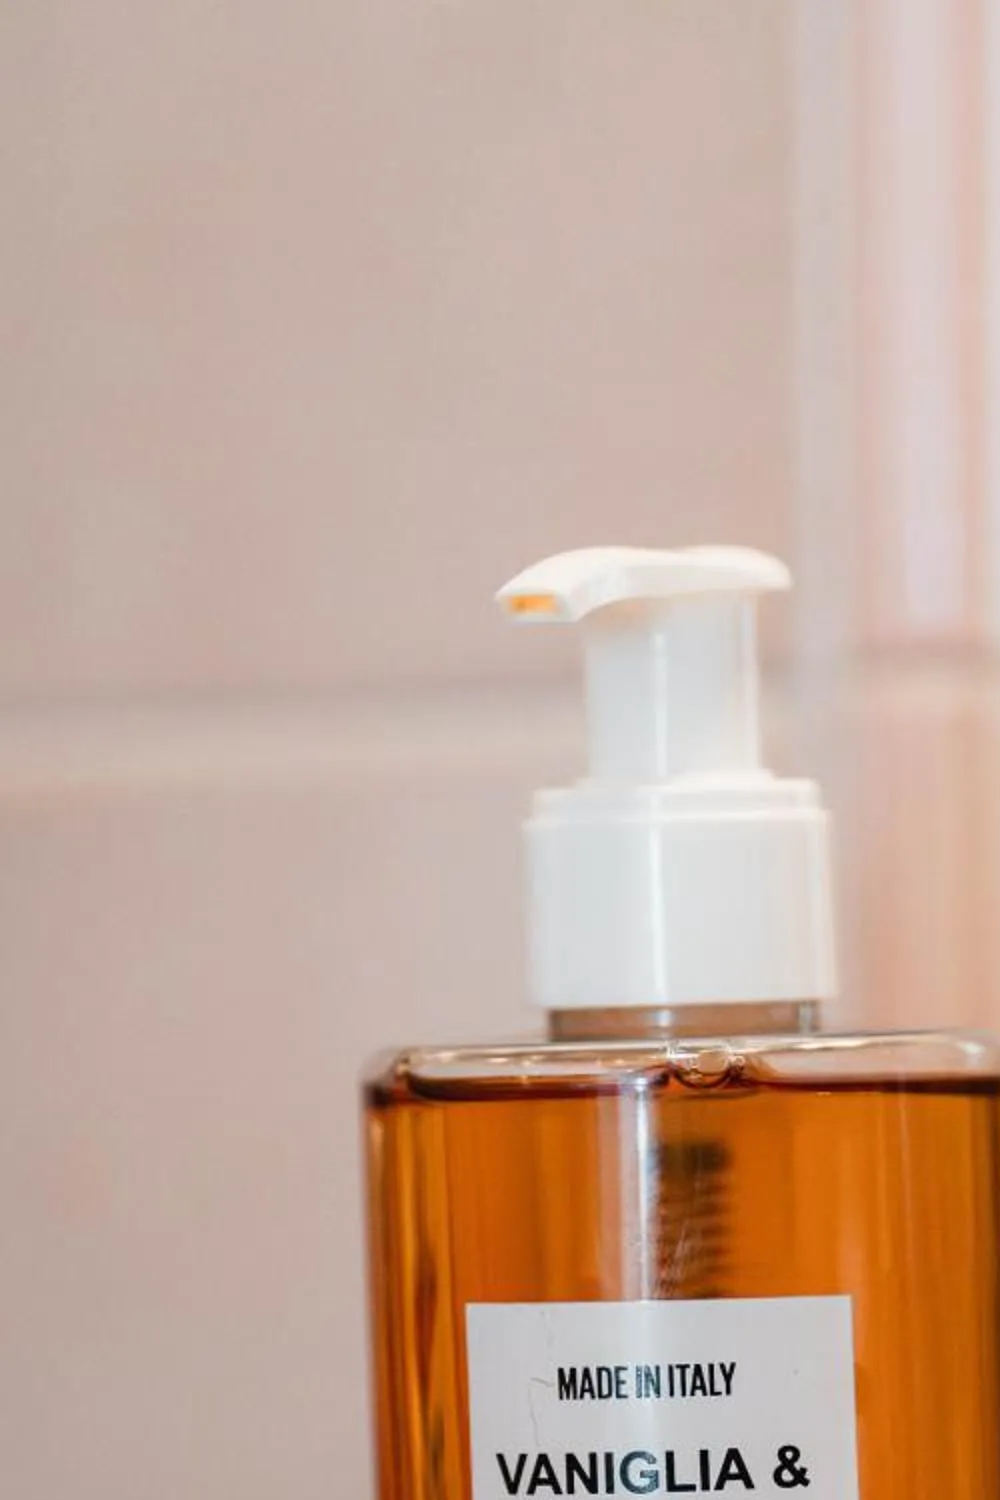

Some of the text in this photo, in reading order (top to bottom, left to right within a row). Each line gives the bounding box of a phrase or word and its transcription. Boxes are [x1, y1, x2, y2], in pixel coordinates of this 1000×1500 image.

[558, 1362, 736, 1400] MADE IN ITALY
[496, 1444, 810, 1495] VANIGLIA &
